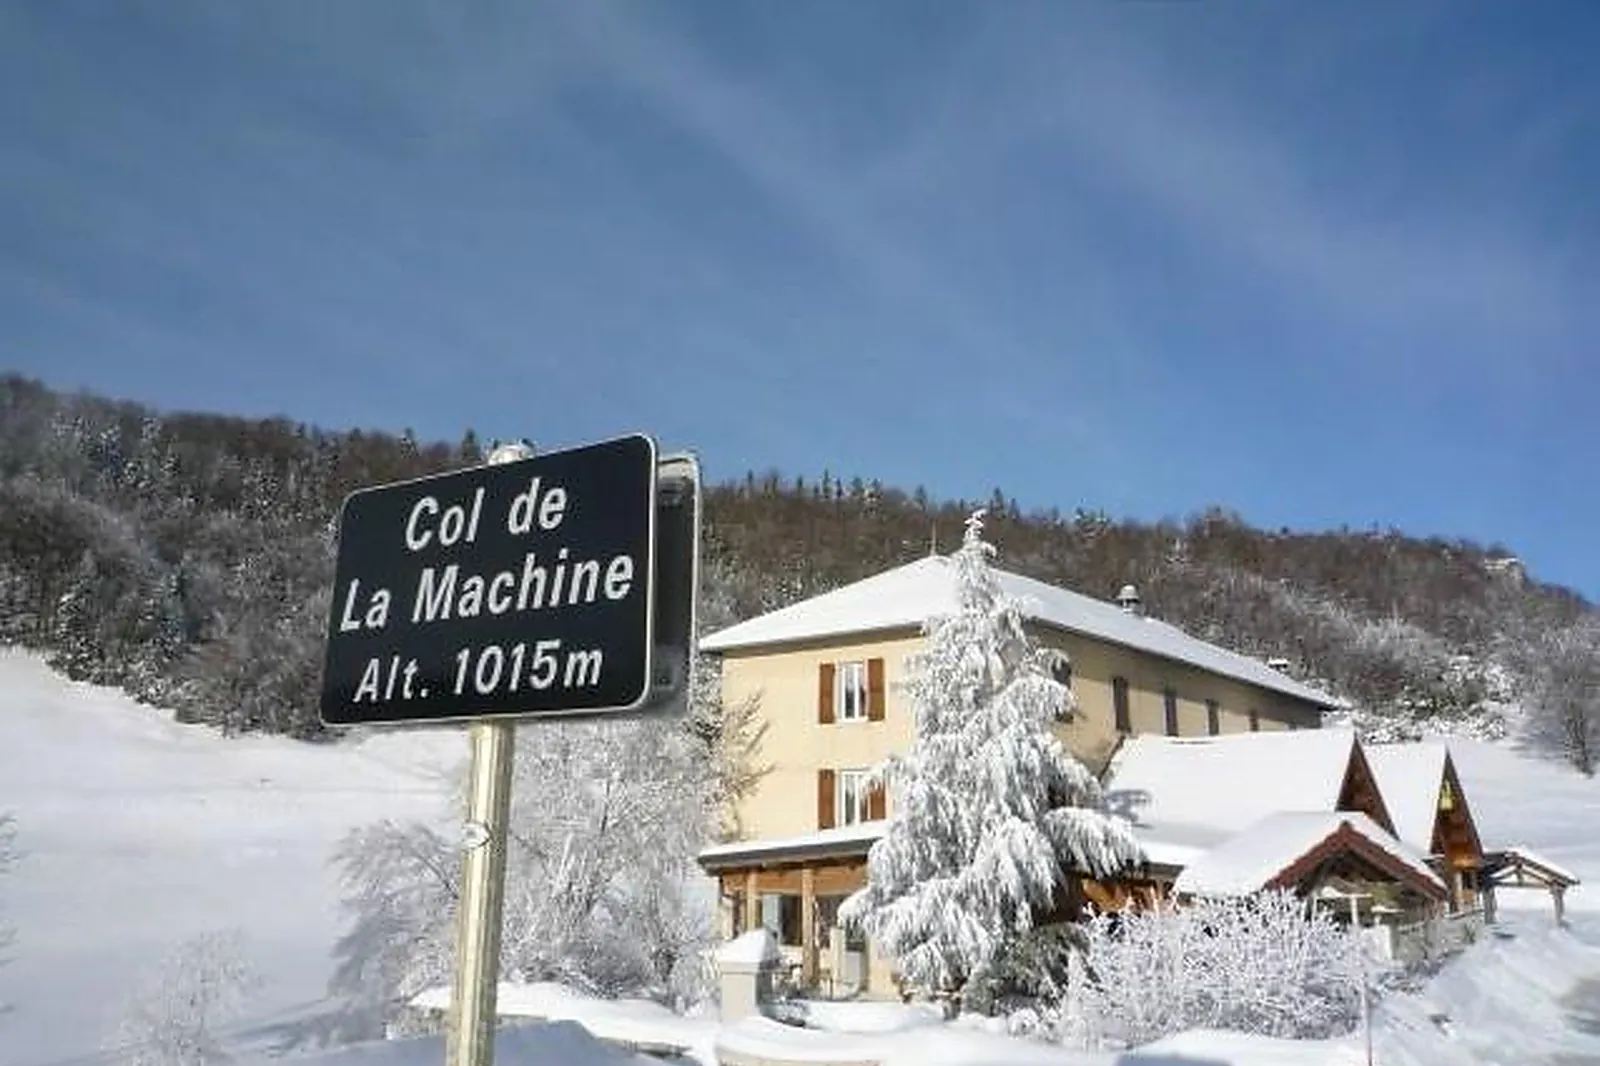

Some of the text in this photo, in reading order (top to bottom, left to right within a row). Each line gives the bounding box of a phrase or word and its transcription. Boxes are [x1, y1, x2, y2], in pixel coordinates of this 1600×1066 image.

[405, 477, 567, 551] Col de
[340, 547, 634, 632] La Machine
[352, 638, 603, 703] Alt. 1015m
